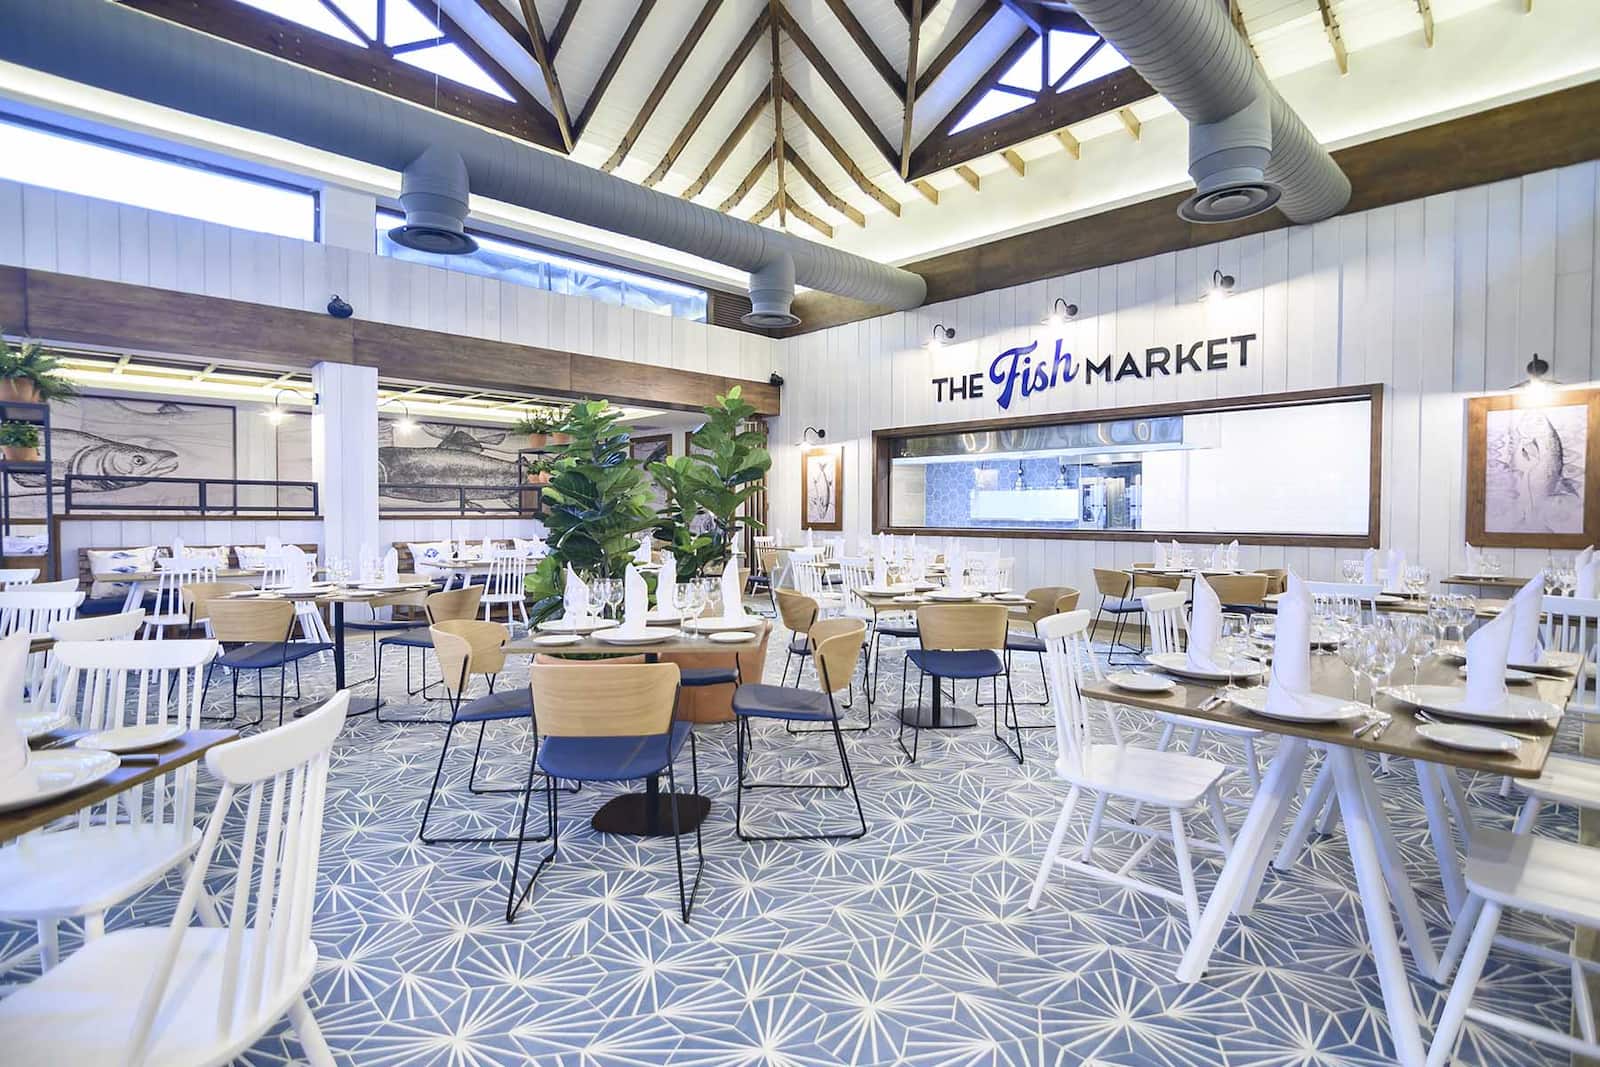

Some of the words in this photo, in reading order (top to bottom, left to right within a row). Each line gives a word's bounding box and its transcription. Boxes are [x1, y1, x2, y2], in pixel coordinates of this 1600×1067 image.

[932, 373, 983, 402] THE
[989, 338, 1079, 409] Fish
[1085, 333, 1256, 384] MARKET
